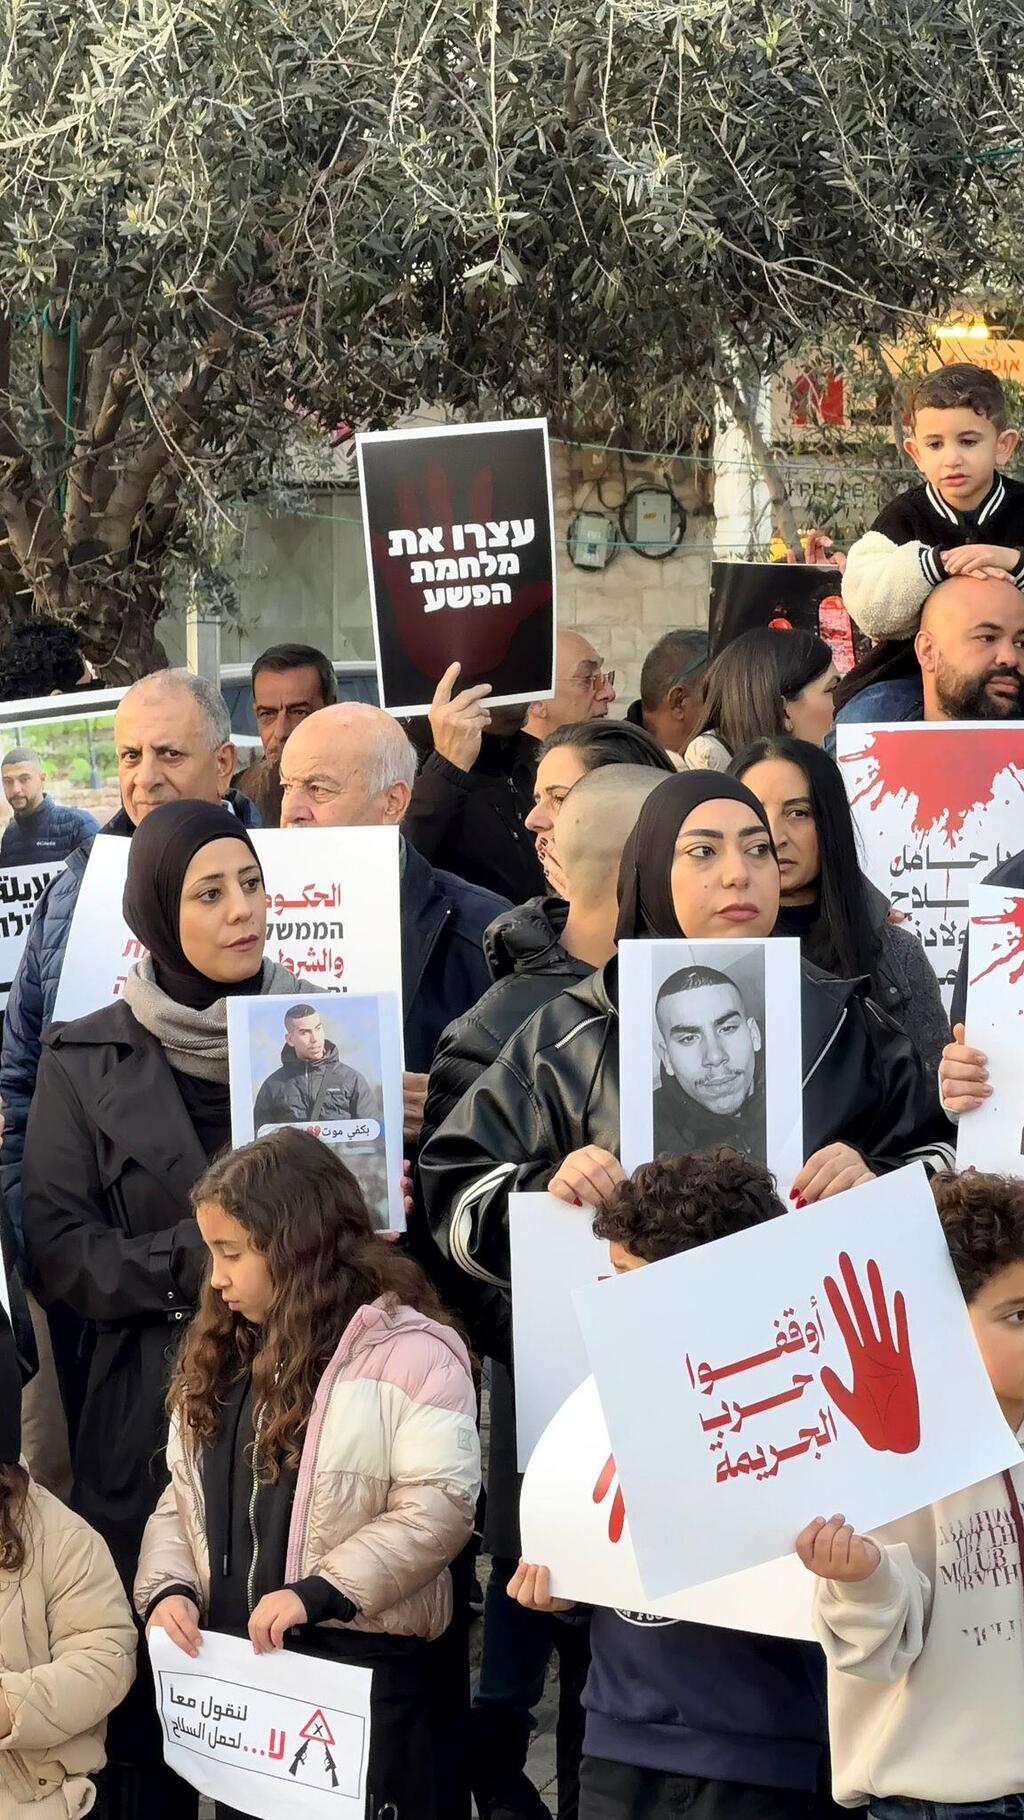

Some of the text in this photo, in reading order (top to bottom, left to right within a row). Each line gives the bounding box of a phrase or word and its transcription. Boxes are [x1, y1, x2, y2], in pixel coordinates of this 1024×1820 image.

[388, 518, 535, 557] עצרו את
[410, 550, 520, 583] מלחמת
[422, 581, 512, 613] הפשע
[890, 843, 989, 877] حامل
[321, 1125, 370, 1140] بكفي موت
[686, 1295, 825, 1396] أوقفوا
[699, 1374, 814, 1438] حرب
[715, 1405, 838, 1483] الجريمة
[201, 1695, 248, 1721] لنقول
[171, 1716, 206, 1741] السلاح
